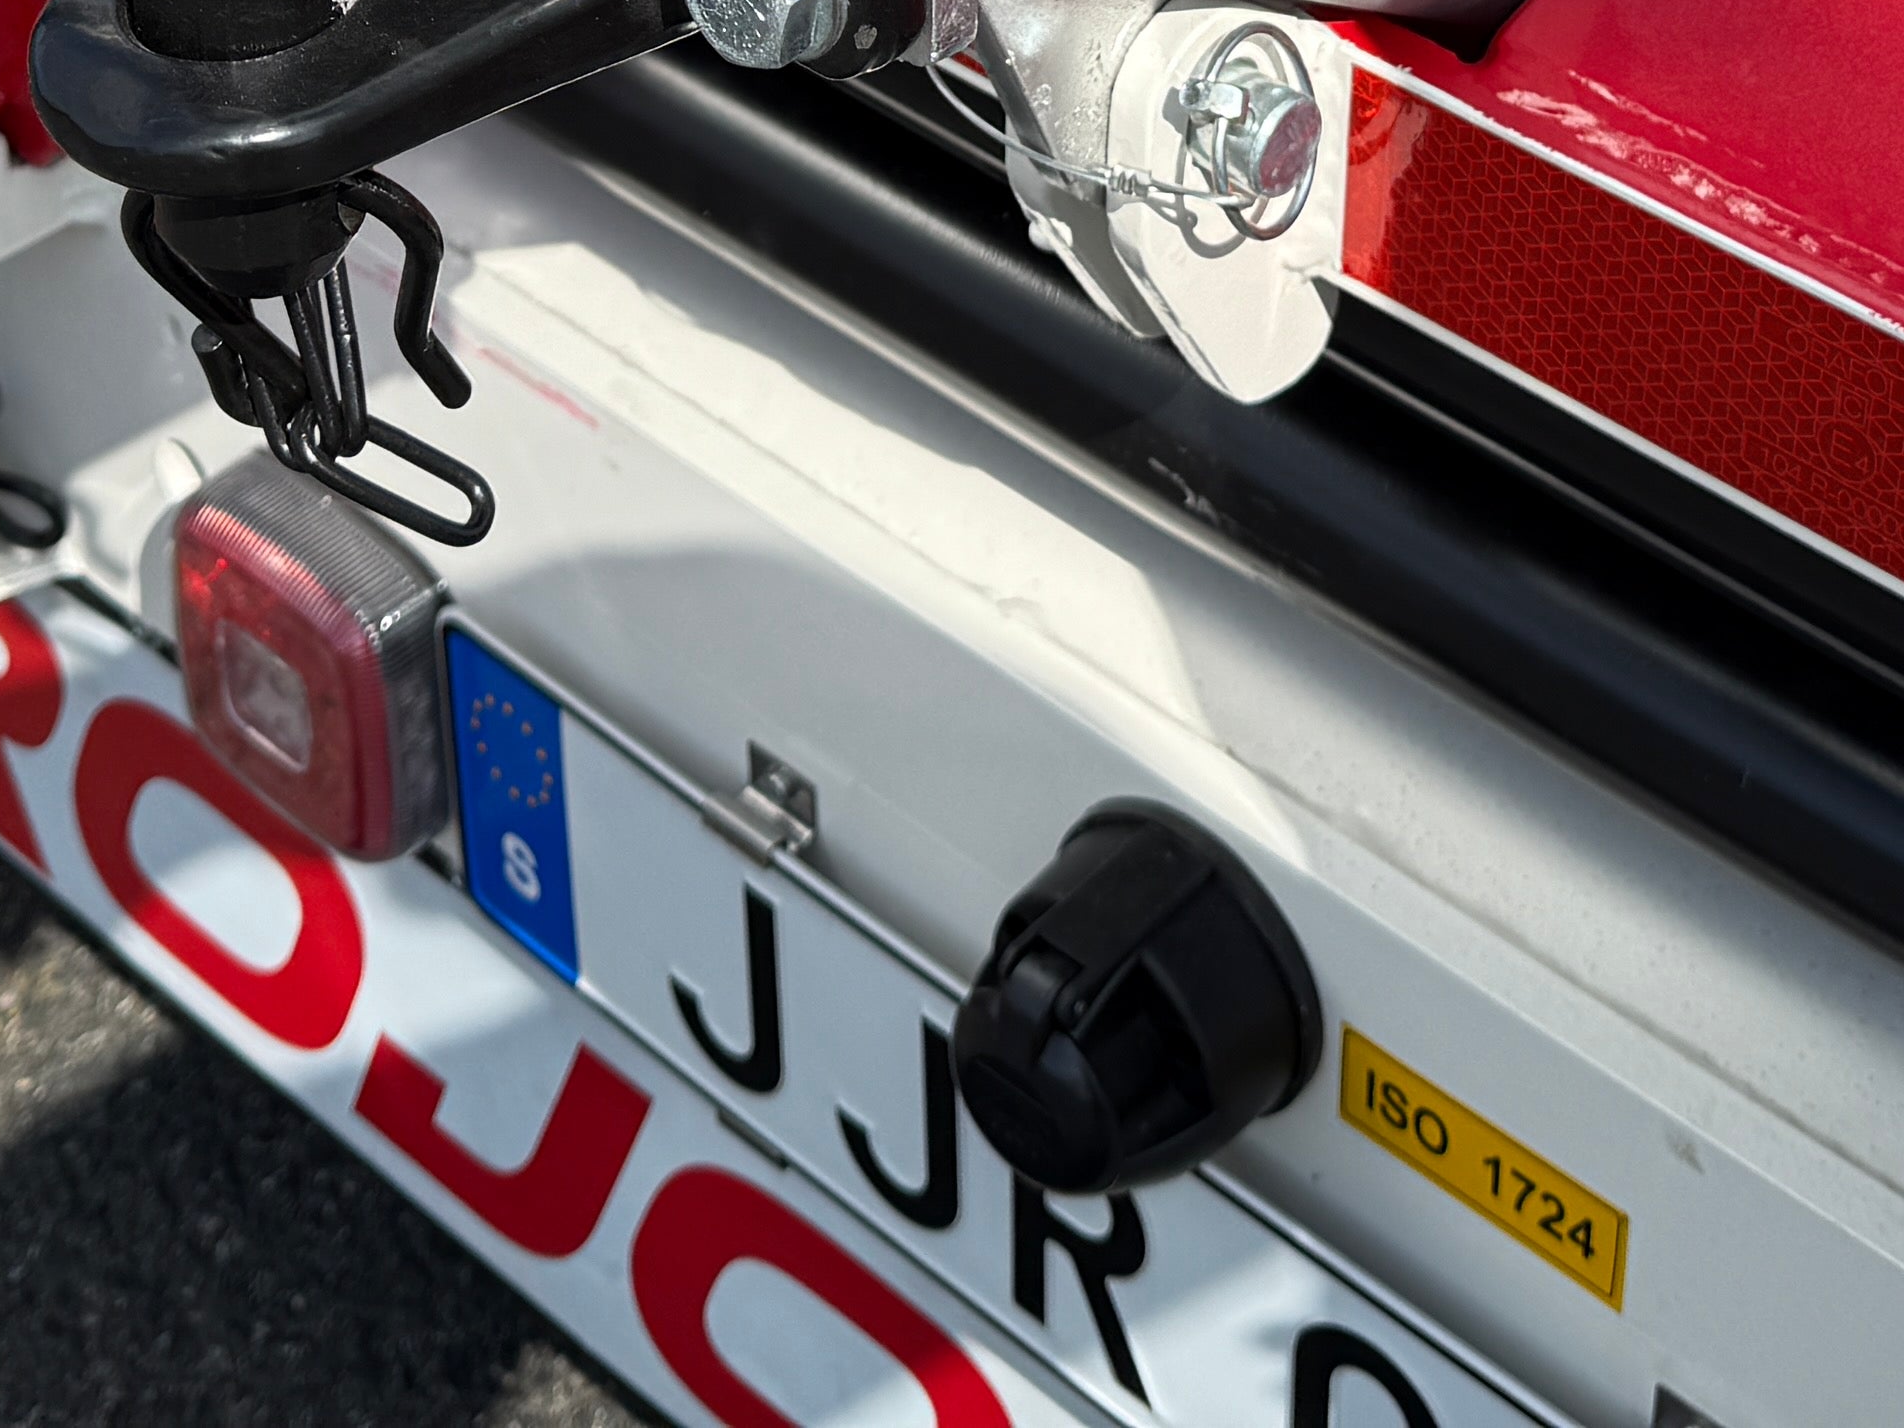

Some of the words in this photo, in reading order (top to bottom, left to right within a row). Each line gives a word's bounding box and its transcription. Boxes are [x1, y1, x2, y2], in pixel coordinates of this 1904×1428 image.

[501, 831, 542, 903] S
[1363, 1068, 1449, 1156] ISO
[1482, 1155, 1595, 1260] 1724
